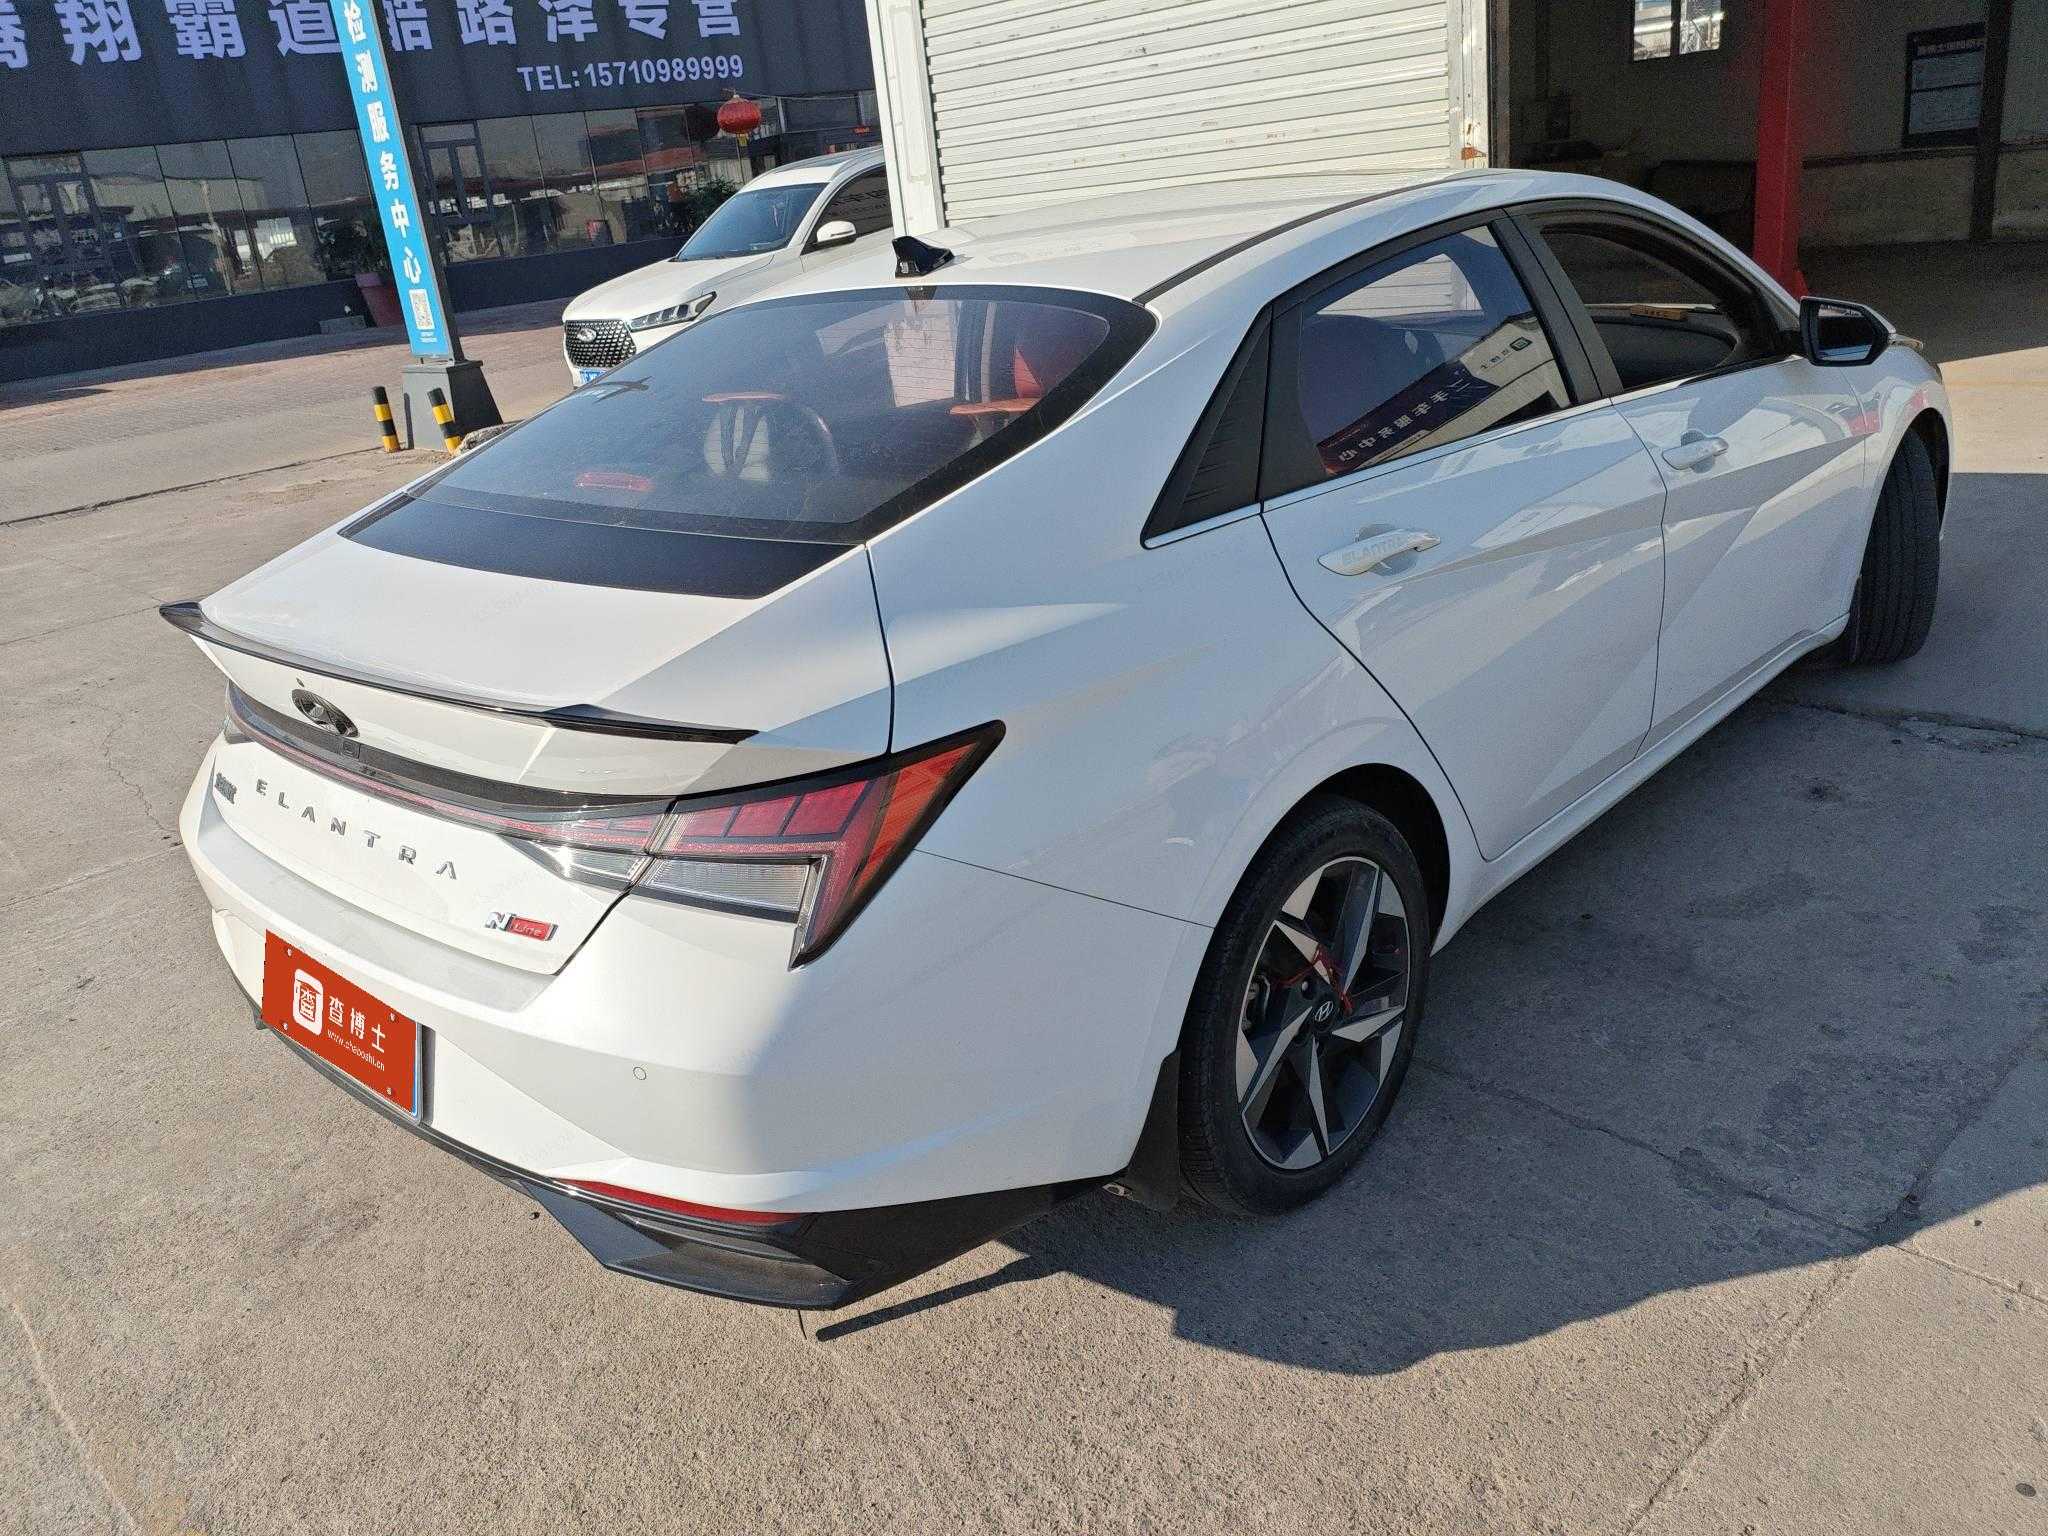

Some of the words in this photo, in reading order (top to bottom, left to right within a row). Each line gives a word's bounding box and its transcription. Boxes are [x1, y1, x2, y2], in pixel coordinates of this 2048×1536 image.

[517, 54, 744, 91] TEL:15710989999
[343, 0, 421, 284] 检测服务中心
[256, 778, 457, 880] ELANTRA
